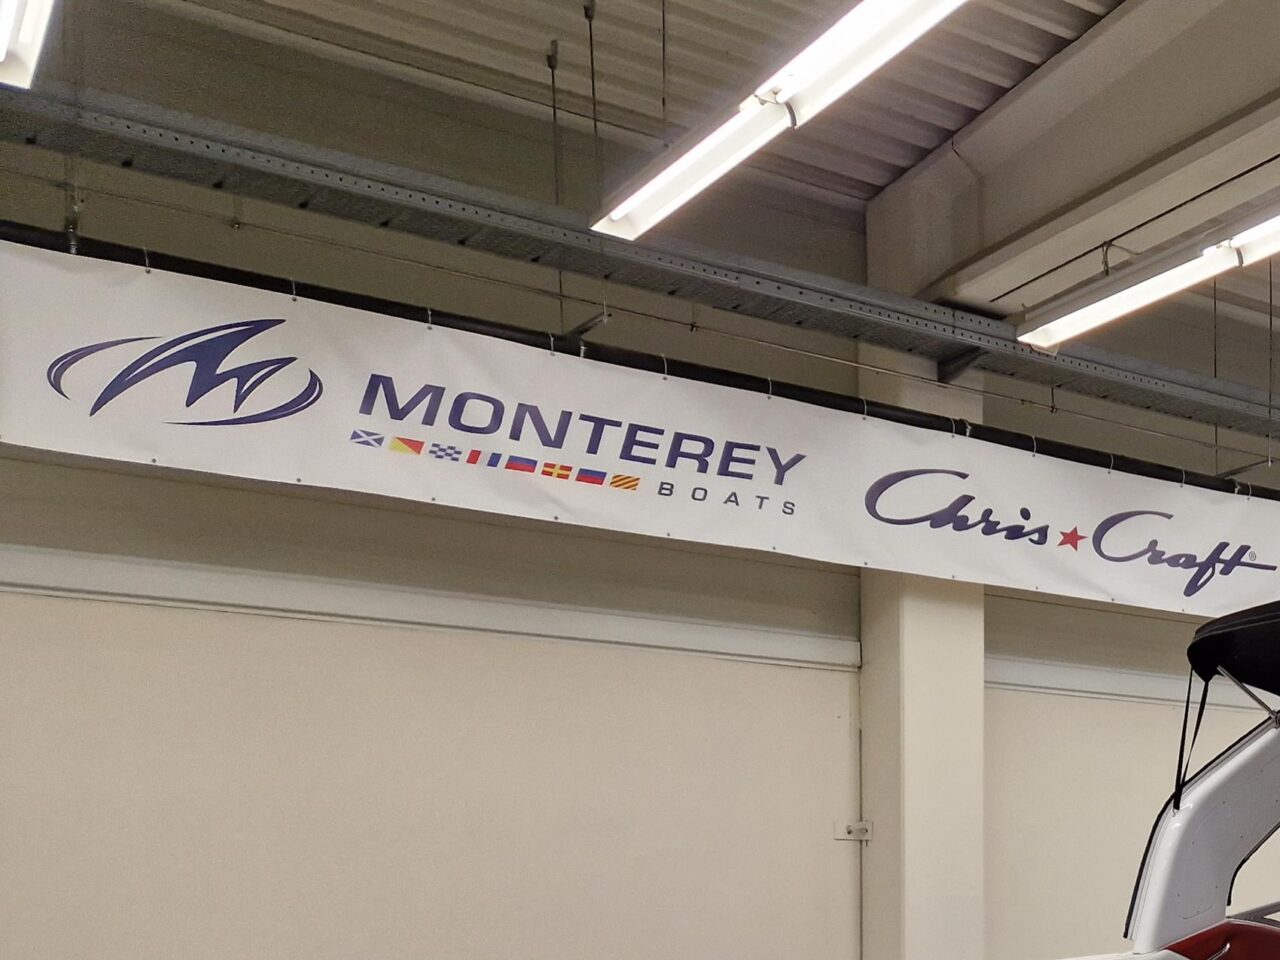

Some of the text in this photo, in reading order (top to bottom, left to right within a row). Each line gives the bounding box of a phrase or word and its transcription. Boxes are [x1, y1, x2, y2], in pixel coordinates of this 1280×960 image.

[359, 372, 807, 487] MONTEREY
[656, 481, 799, 517] BOATS
[864, 467, 1278, 598] Chris Craft
